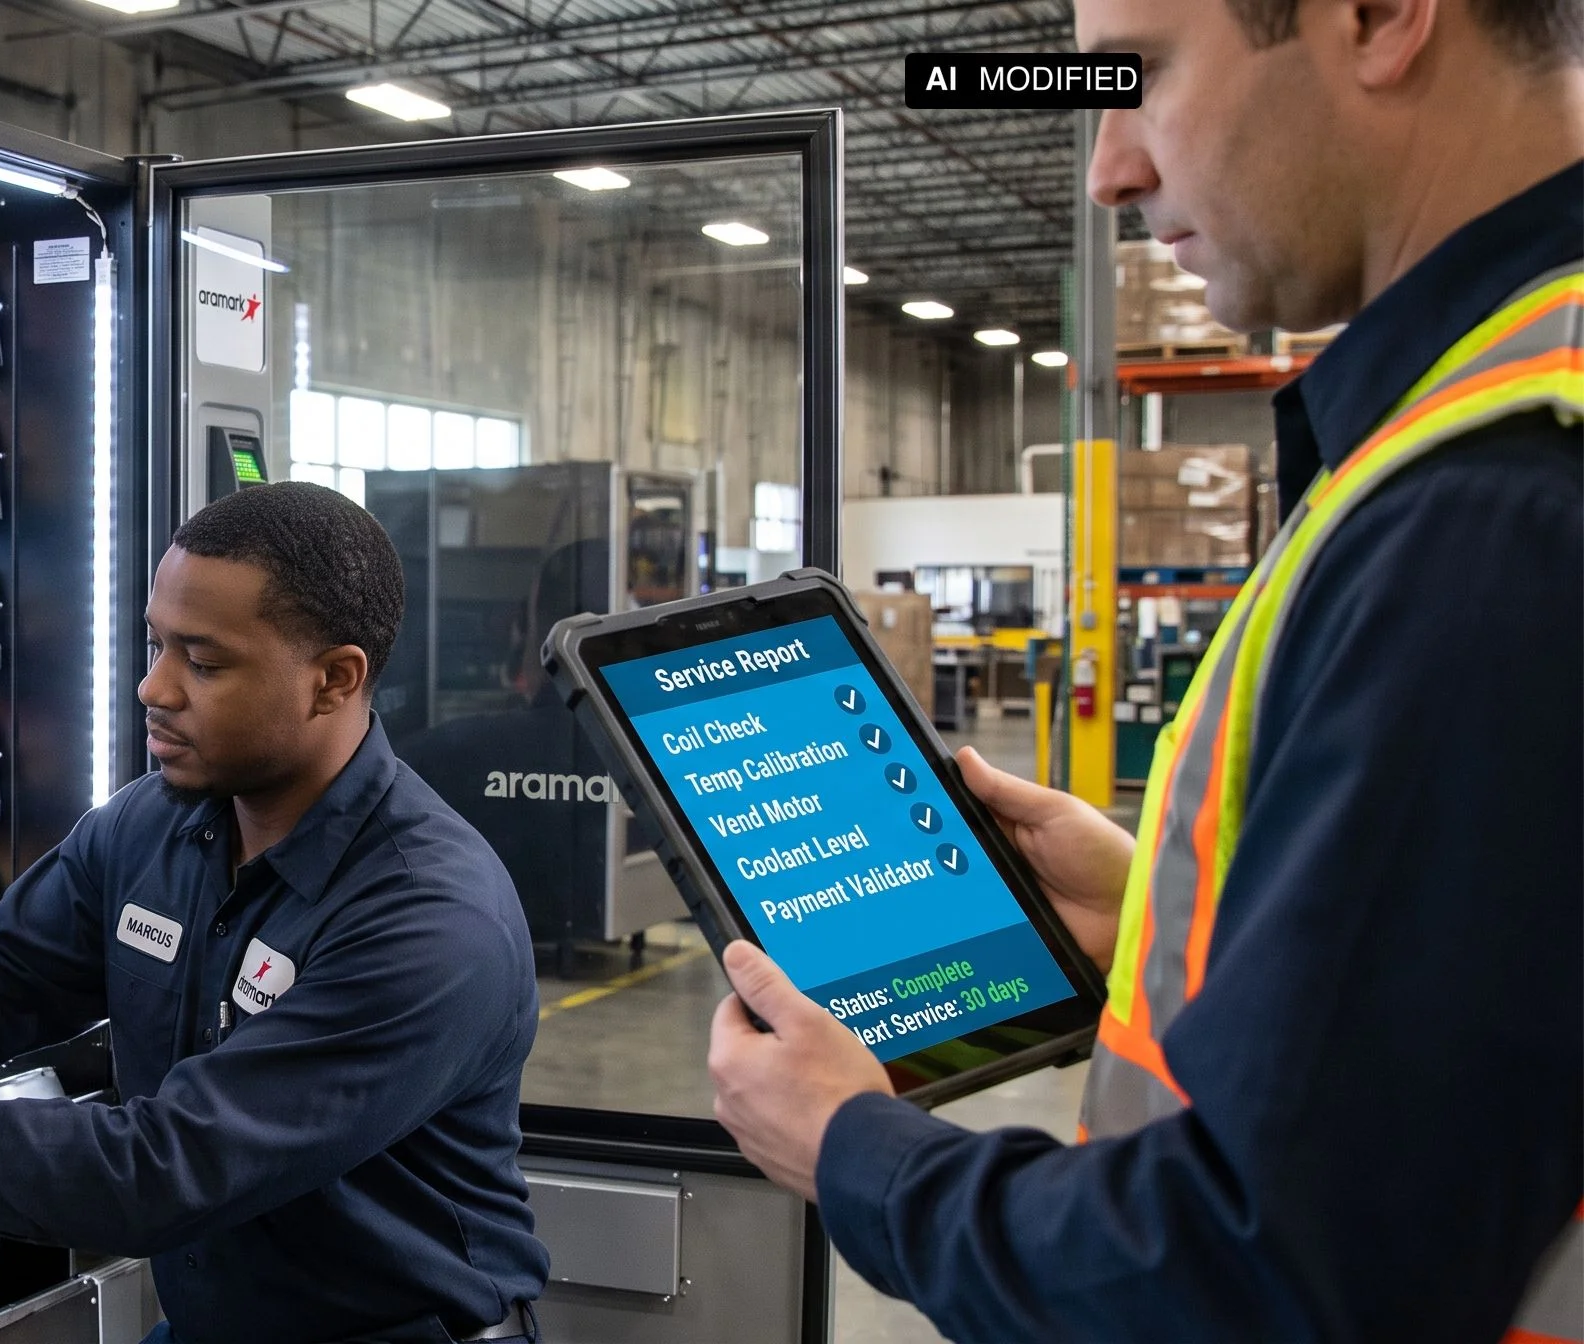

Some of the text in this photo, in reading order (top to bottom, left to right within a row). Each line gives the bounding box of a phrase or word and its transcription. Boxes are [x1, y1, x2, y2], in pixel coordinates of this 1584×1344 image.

[199, 290, 246, 312] aramark
[654, 638, 811, 692] Service Report
[662, 712, 768, 755] Coil Check
[484, 771, 620, 803] arama
[684, 740, 849, 796] Temp Calibration
[708, 793, 824, 838] Vend Motor
[736, 824, 870, 881] Coolant Level
[760, 858, 935, 924] Payment Validator
[125, 917, 174, 948] MARCUS
[829, 959, 975, 1020] Status: Complete
[890, 998, 964, 1035] Service:
[959, 987, 987, 1012] 30
[988, 975, 1030, 1005] days
